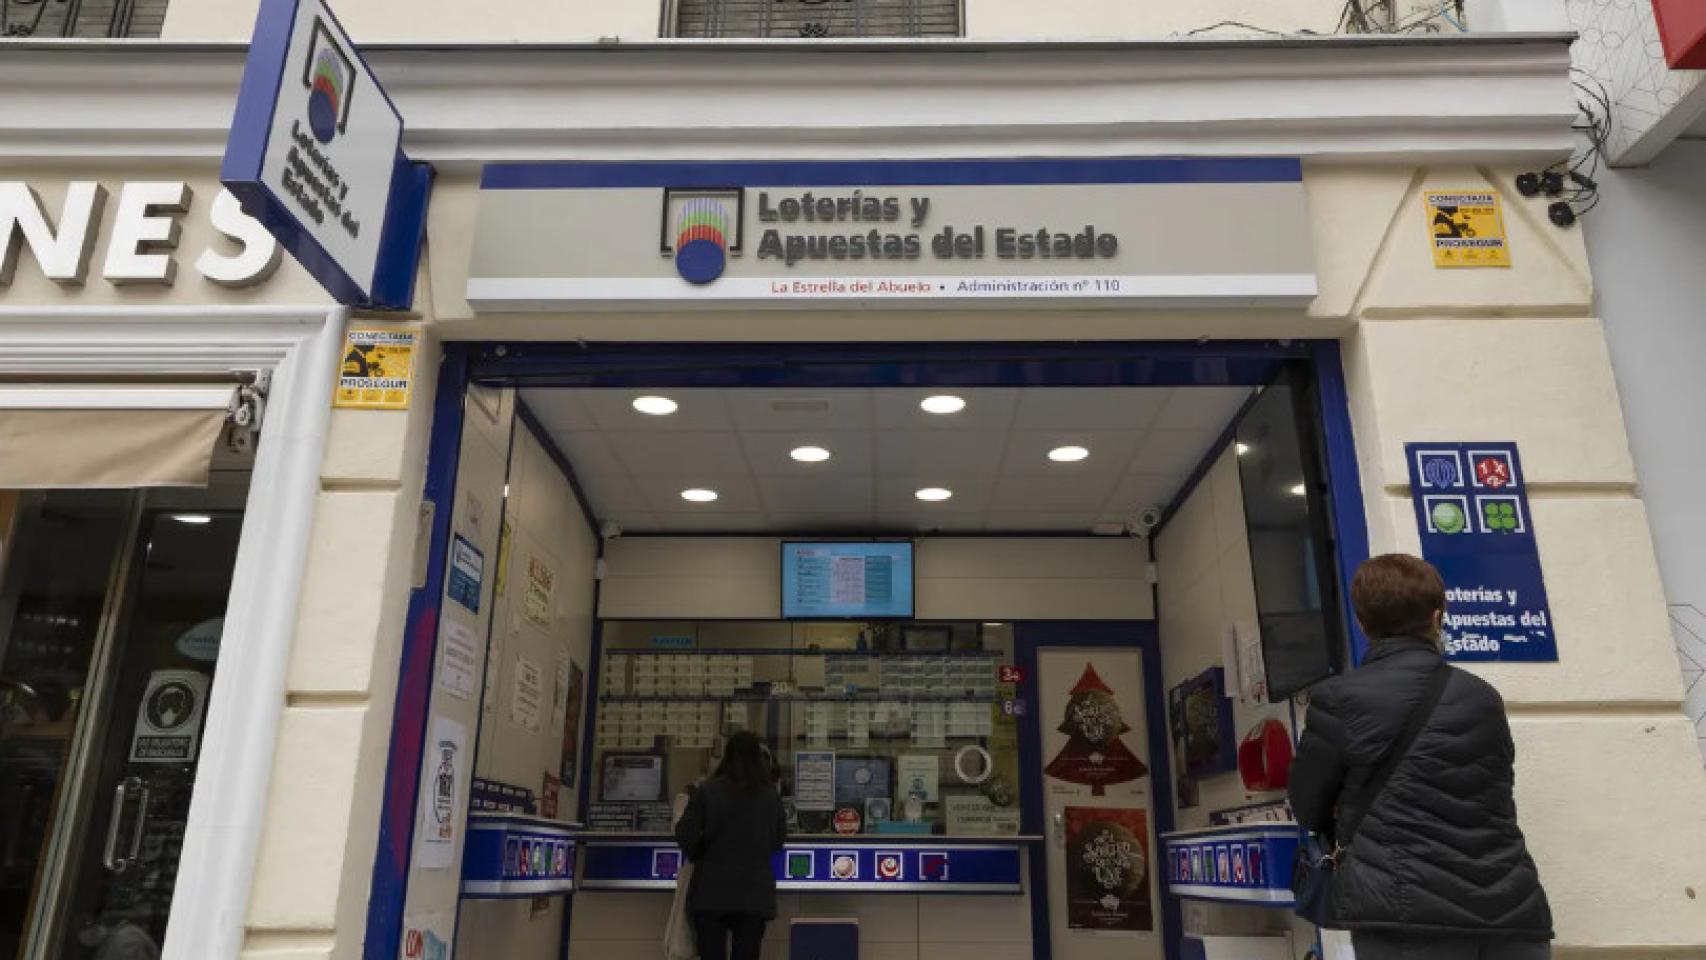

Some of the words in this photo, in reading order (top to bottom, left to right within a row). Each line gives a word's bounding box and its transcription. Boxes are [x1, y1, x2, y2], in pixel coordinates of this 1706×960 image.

[292, 119, 340, 188] Loterías
[339, 182, 349, 201] y
[282, 166, 324, 224] Estado
[286, 145, 341, 218] Apuestas
[341, 210, 360, 238] del
[759, 189, 899, 222] Loterías
[910, 197, 931, 228] y
[757, 229, 920, 267] Apuestas
[932, 225, 984, 259] del
[996, 225, 1118, 259] Estado
[771, 282, 788, 294] La
[793, 281, 847, 294] Estrella
[849, 281, 874, 294] del
[877, 281, 931, 294] Abuelo
[957, 279, 1069, 293] Administración
[1095, 279, 1120, 292] 110
[341, 379, 407, 389] PROSEGUR
[1444, 585, 1503, 603] oterías
[1506, 589, 1518, 607] y
[1442, 610, 1516, 631] Apuestas
[1520, 610, 1547, 627] del
